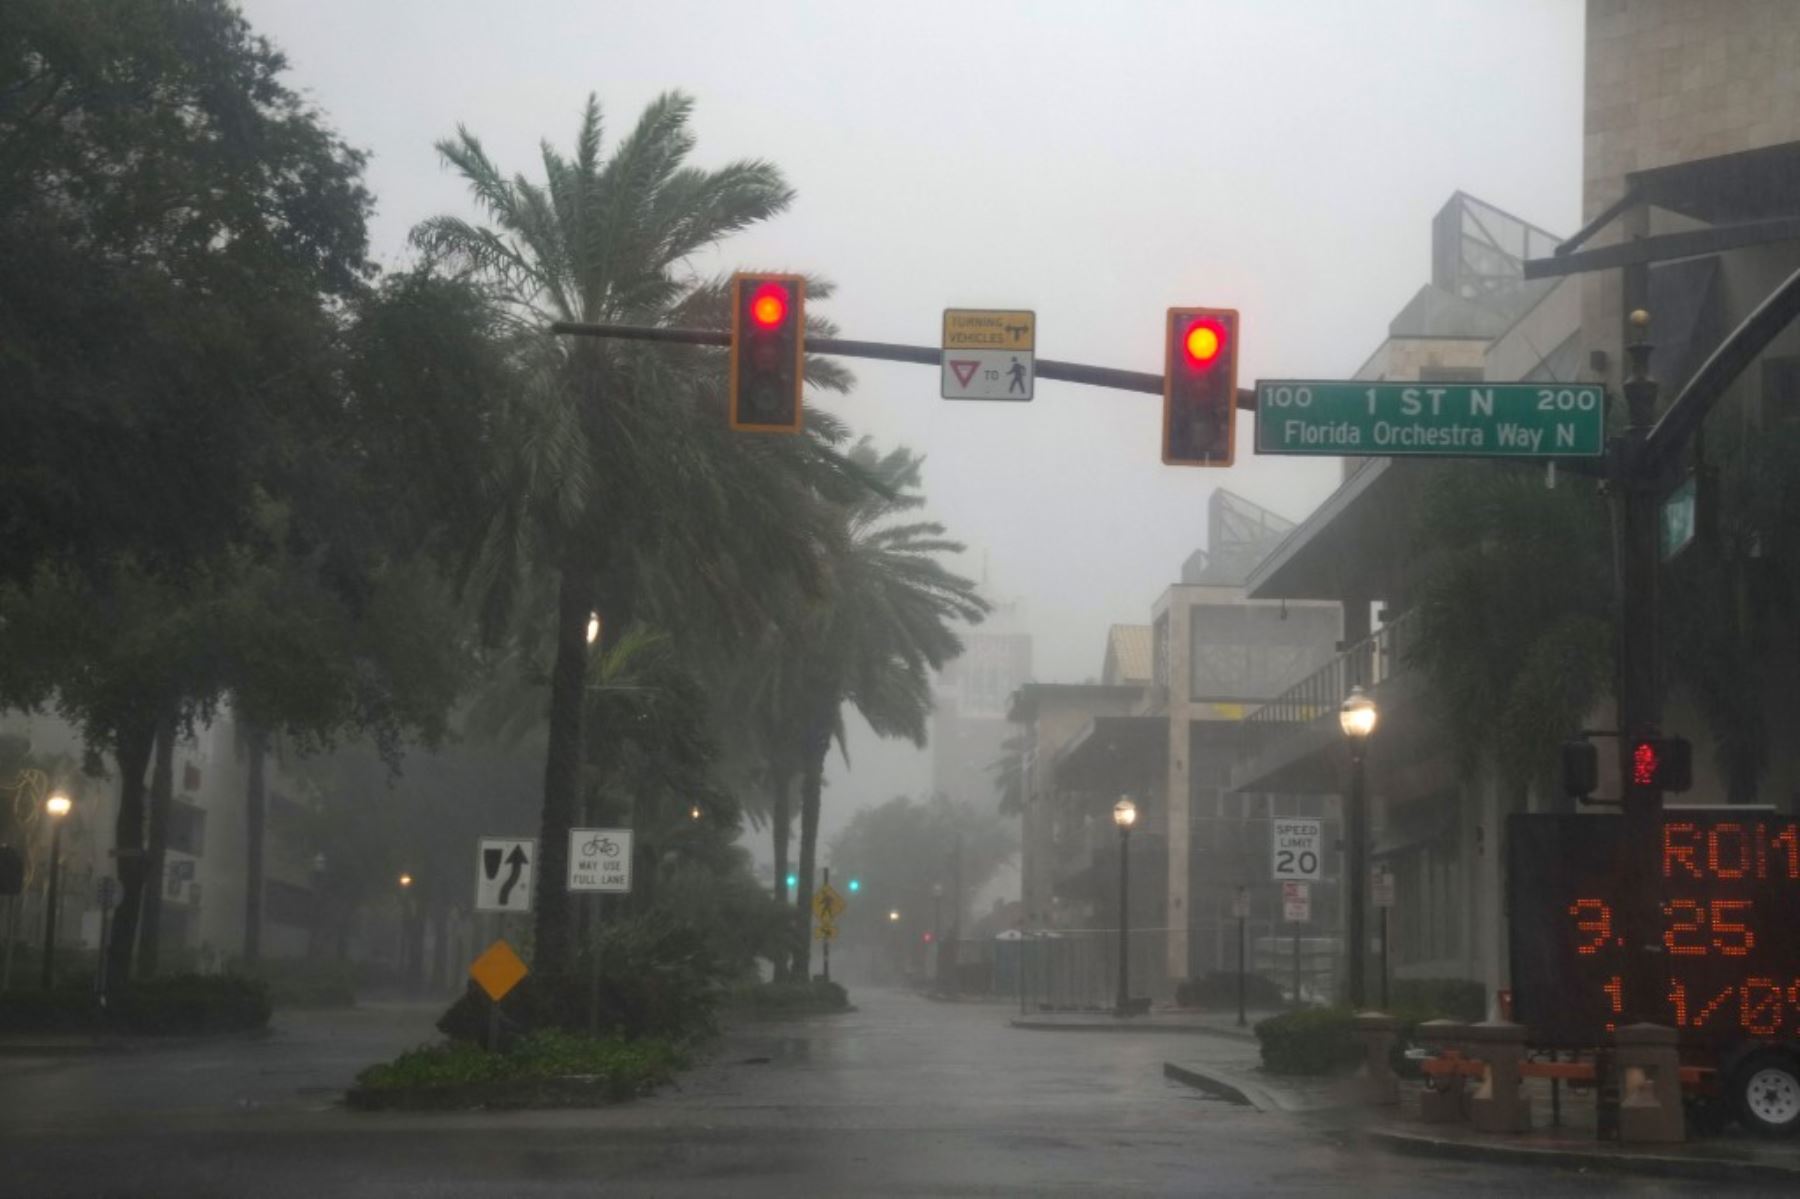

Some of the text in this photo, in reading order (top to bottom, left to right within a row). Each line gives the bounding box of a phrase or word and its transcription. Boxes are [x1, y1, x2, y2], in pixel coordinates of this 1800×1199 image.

[984, 369, 999, 381] TO
[1265, 387, 1595, 416] 100 1 ST N 200
[1285, 420, 1575, 451] Florida Orchestra Way N
[1276, 825, 1317, 836] SPEED
[1280, 838, 1312, 849] LIMIT
[579, 861, 621, 871] MAY USE
[1276, 850, 1317, 874] 20
[573, 875, 625, 885] FULL LANE
